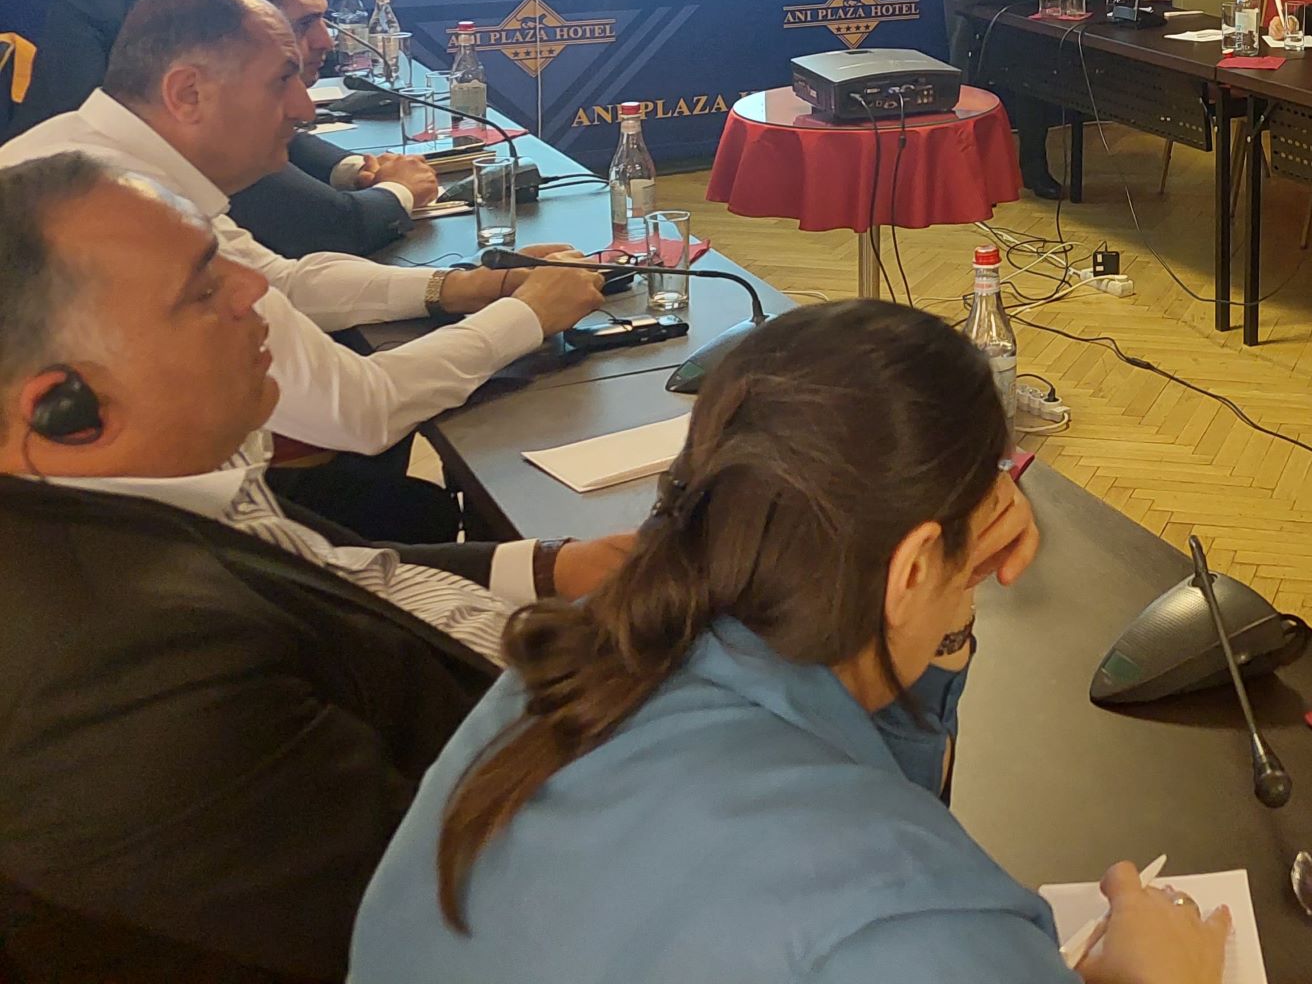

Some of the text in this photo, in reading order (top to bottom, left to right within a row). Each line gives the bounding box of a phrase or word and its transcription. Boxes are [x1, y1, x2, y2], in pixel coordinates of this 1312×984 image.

[784, 2, 920, 23] ANI PLAZA HOTEL
[448, 24, 615, 48] AI PLAZA HOTEL
[638, 94, 729, 120] PLAZA
